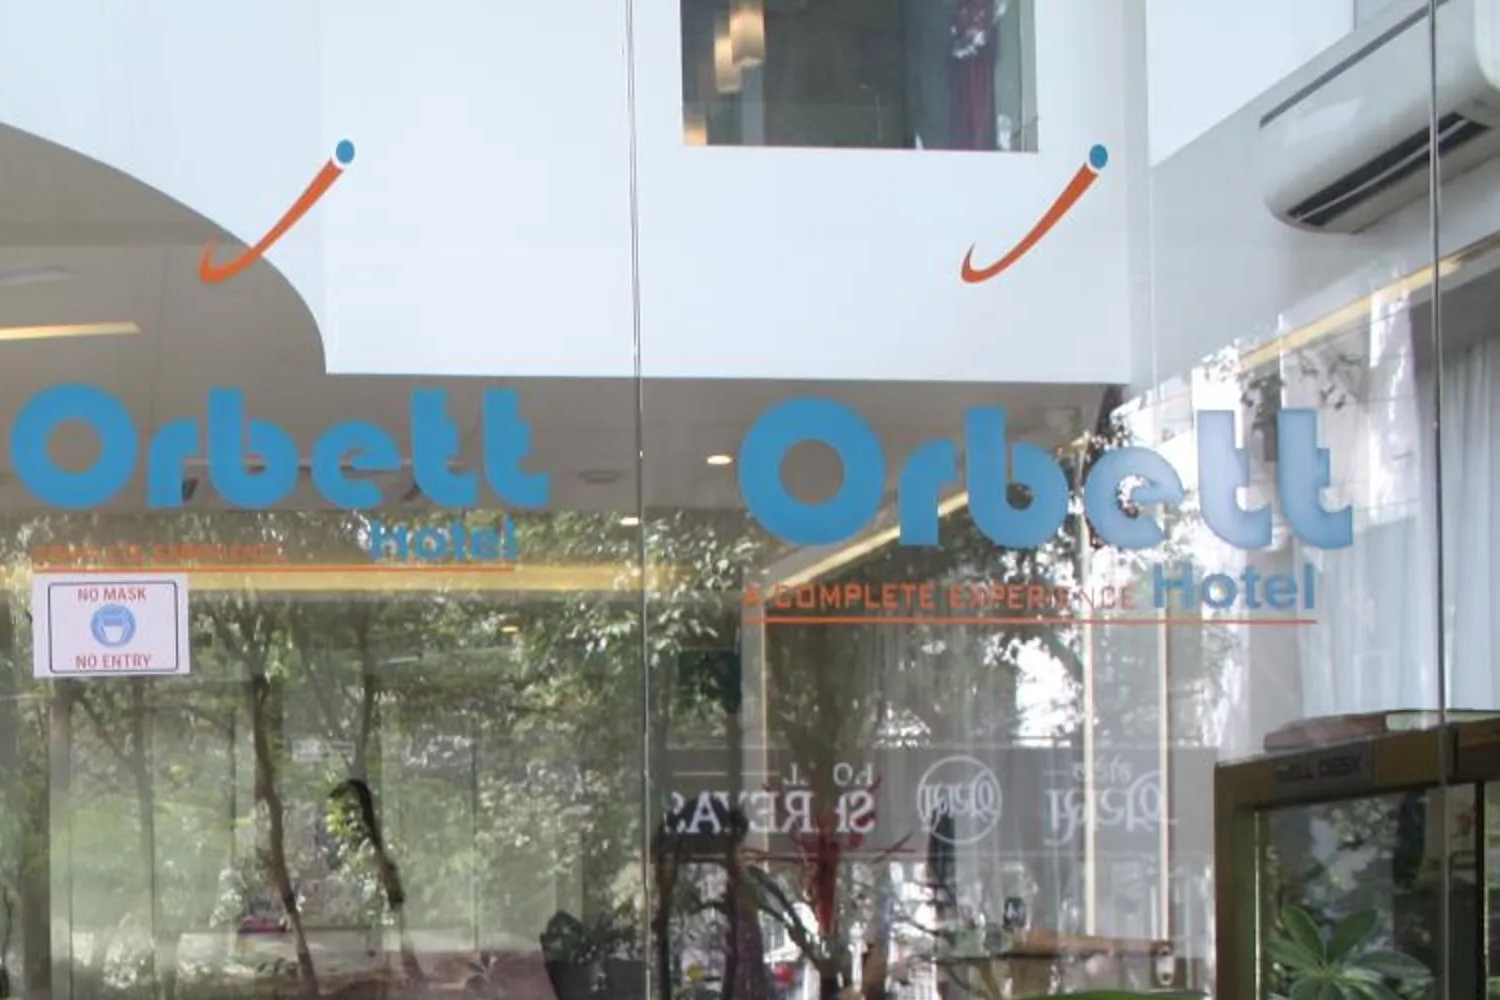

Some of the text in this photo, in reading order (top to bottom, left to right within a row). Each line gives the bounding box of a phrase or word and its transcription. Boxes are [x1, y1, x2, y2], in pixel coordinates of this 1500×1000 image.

[10, 383, 549, 510] Orbett
[737, 396, 1353, 550] Orbett
[370, 517, 516, 560] Hotel
[77, 586, 147, 601] NO MASK
[774, 583, 936, 609] COMPLETE
[947, 583, 1138, 610] EXPERIENCE
[1153, 564, 1316, 609] Hotel
[75, 653, 152, 668] NO ENTRY
